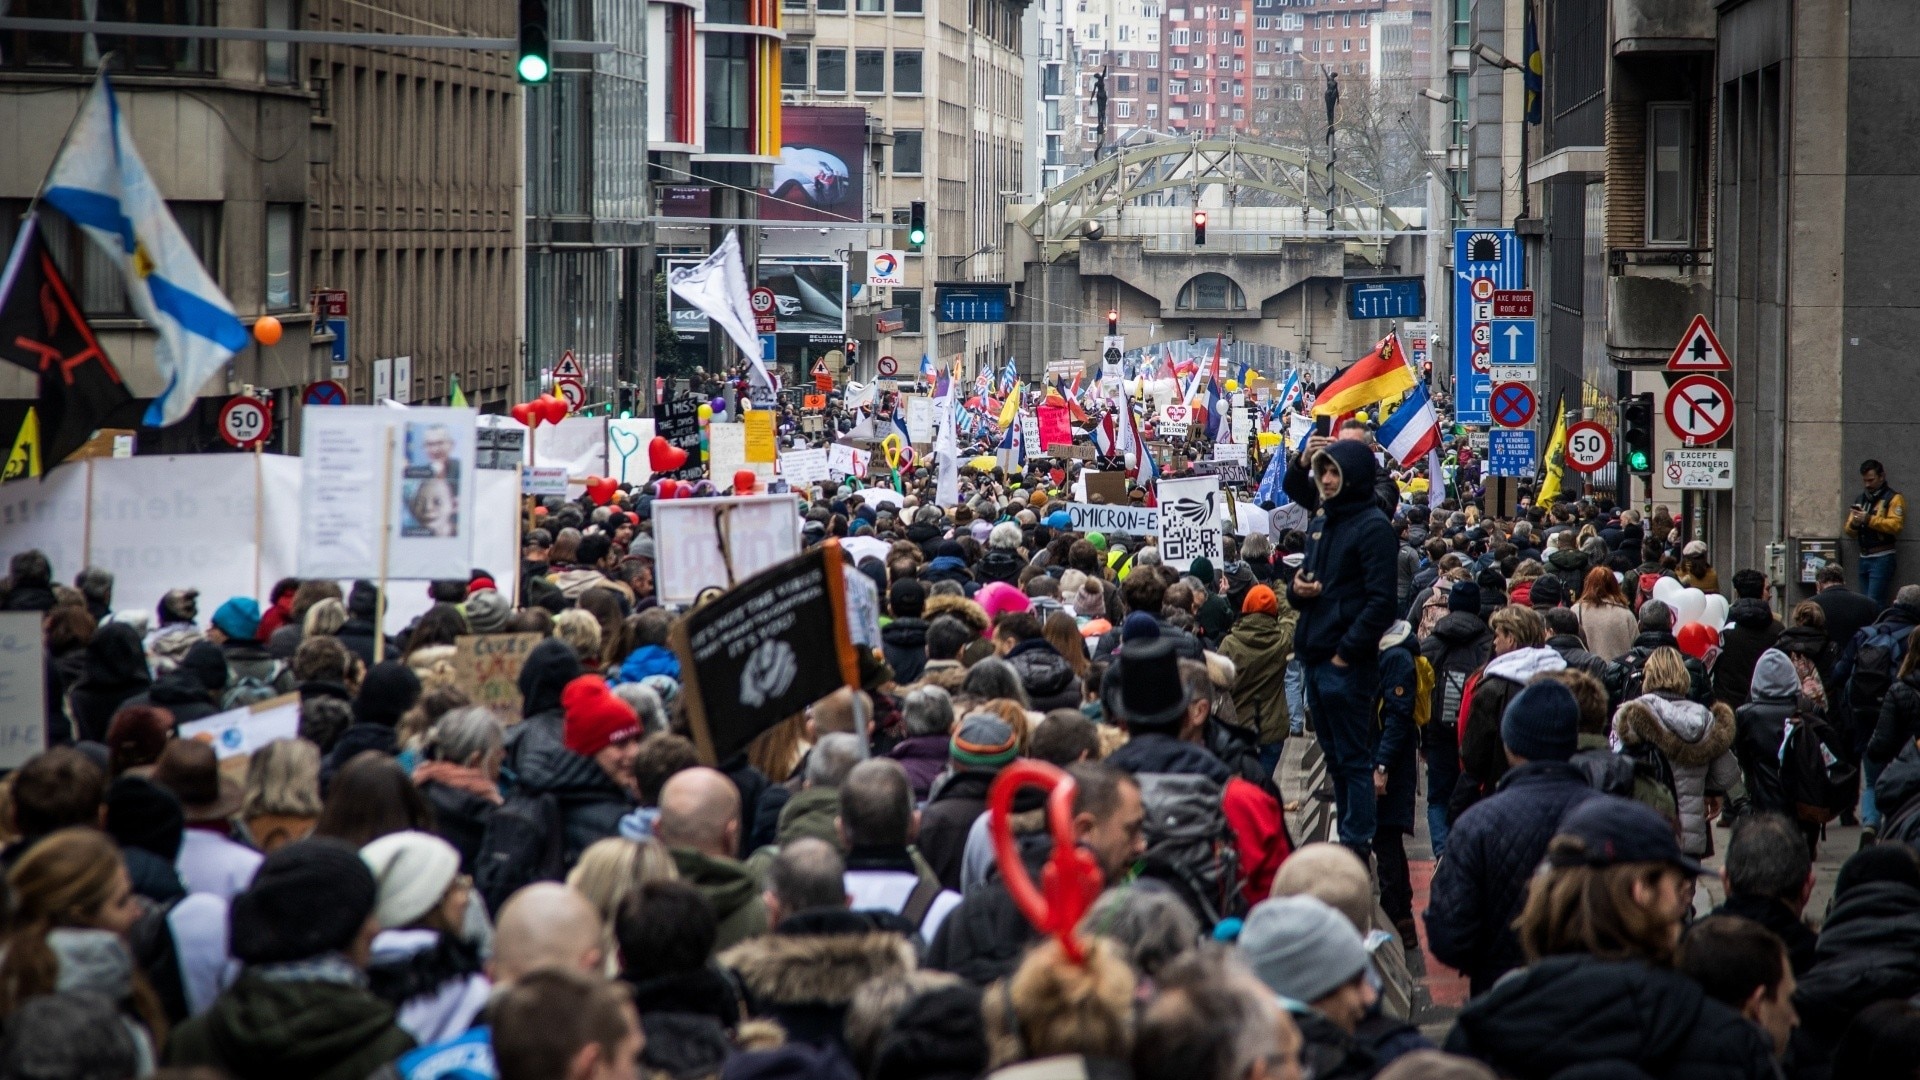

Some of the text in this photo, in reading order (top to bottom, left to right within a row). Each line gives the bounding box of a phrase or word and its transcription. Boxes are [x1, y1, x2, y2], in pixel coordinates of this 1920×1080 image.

[870, 276, 900, 284] TOTAL
[754, 295, 769, 304] 50
[1480, 306, 1488, 318] E
[1477, 330, 1484, 340] 3
[1478, 356, 1482, 364] 3
[664, 400, 697, 417] I MISS
[232, 411, 258, 428] 50
[1574, 436, 1600, 452] 50
[1580, 454, 1594, 462] km
